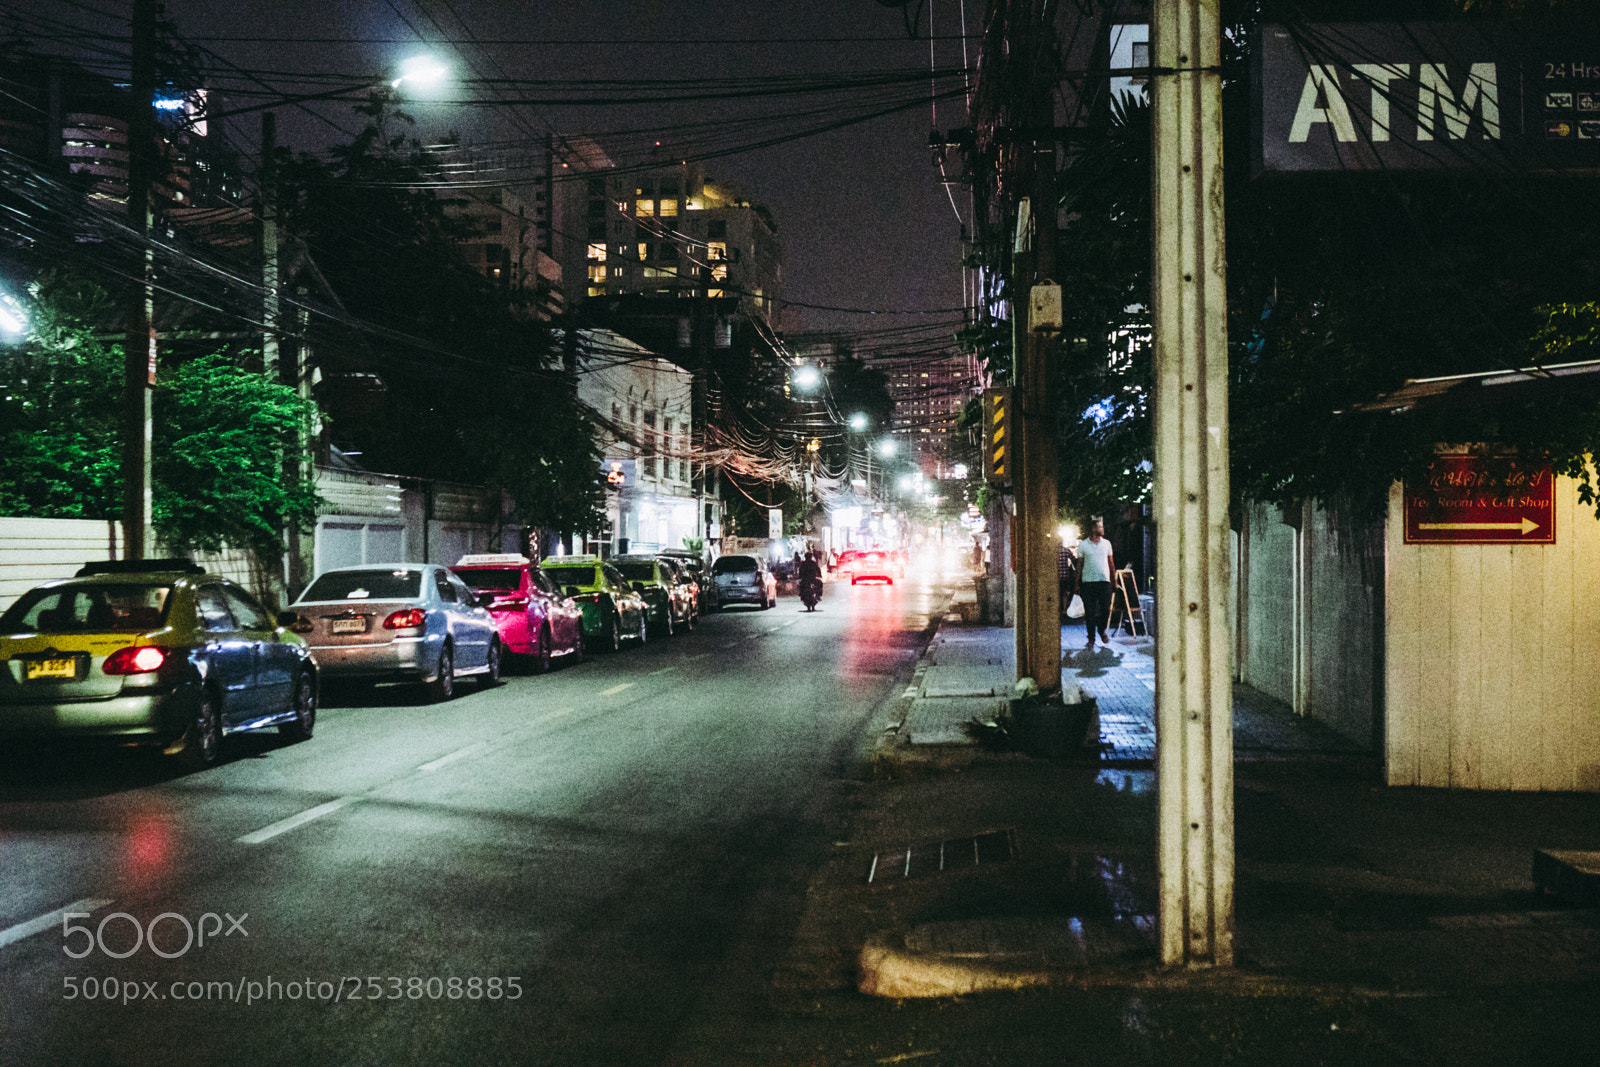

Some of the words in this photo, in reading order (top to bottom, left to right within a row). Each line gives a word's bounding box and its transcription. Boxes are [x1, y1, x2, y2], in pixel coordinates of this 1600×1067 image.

[1544, 62, 1566, 78] 24
[1288, 62, 1500, 142] ATM
[1438, 496, 1473, 508] Room
[1477, 497, 1487, 508] &
[1519, 496, 1549, 510] Shop
